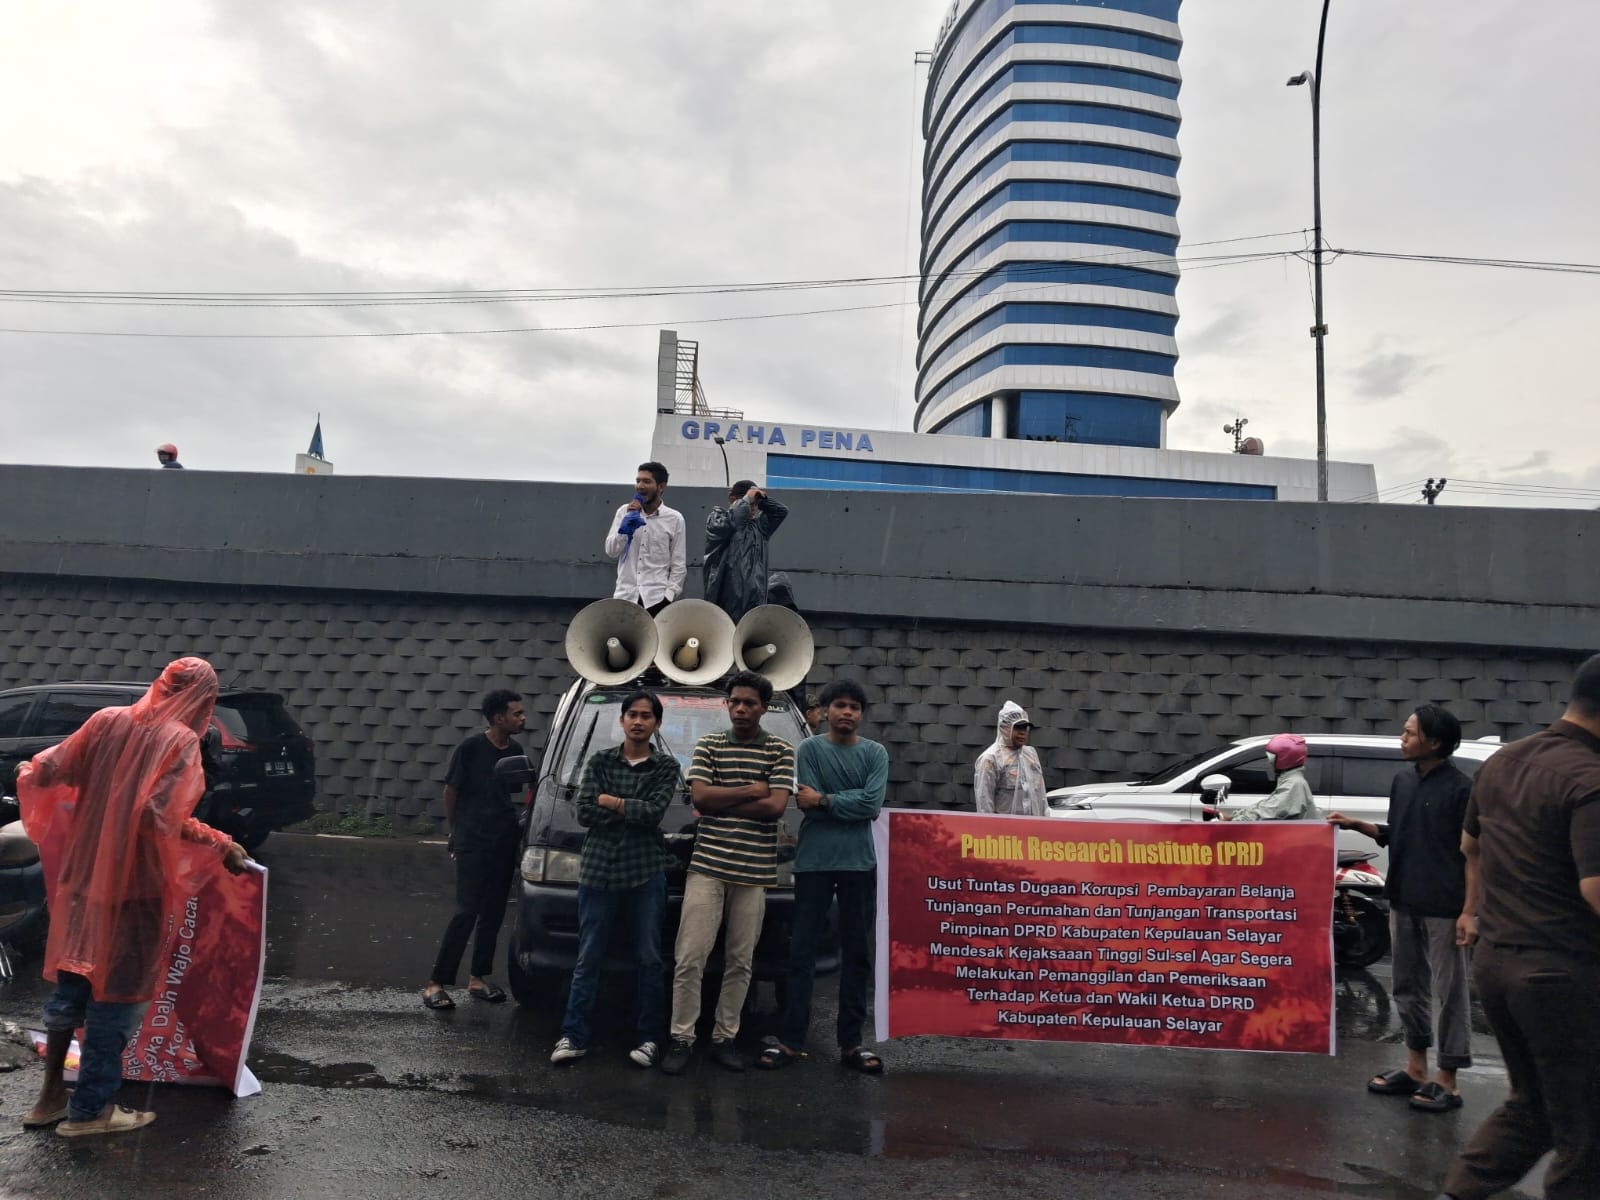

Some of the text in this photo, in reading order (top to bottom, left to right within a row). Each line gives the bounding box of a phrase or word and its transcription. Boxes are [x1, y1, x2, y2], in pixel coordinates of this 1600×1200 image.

[682, 421, 874, 451] GRAHA PENA
[962, 834, 1263, 865] Publik Research Institute (PRI)
[928, 877, 1295, 901] Usut Tuntas Dugaan Korupsi Pembayaran Belanja
[925, 899, 1297, 922] Tunjangan Perumahan dan Tunjangan Transportasi
[940, 921, 1282, 945] Pimpinan DPRD Kabupaten Kepulauan Selayar
[165, 944, 193, 985] Wajo
[930, 942, 1292, 968] Mendesak Kejaksaaan Tinggi Sul-sel Agar Segera
[956, 965, 1266, 988] Melakukan Pemanggilan dan Pemeriksaan
[967, 988, 1255, 1010] Terhadap Ketua dan Wakil Ketua DPRD
[998, 1011, 1222, 1034] Kabupaten Kepulauan Selayar
